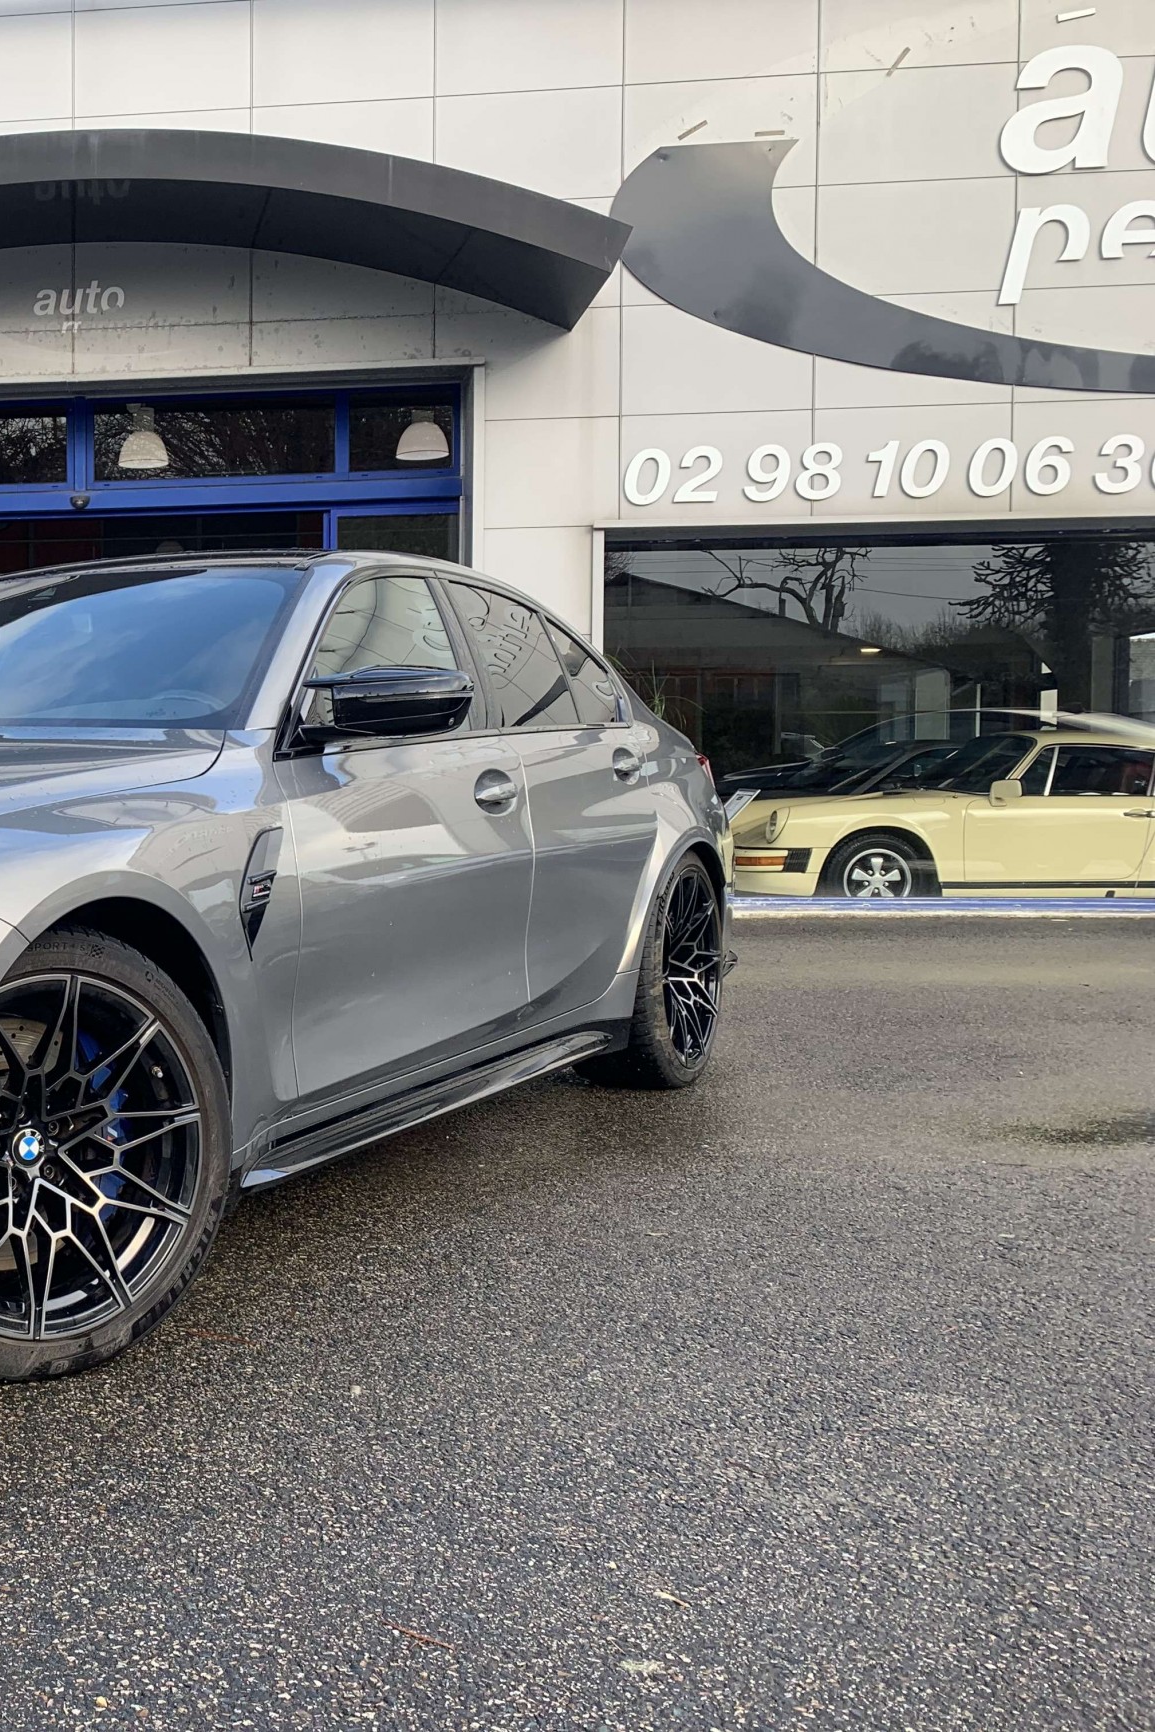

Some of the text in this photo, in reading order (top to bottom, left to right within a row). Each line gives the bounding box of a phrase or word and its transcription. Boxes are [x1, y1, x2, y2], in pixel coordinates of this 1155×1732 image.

[33, 280, 125, 316] auto
[624, 433, 1155, 505] 02 98 10 06 3
